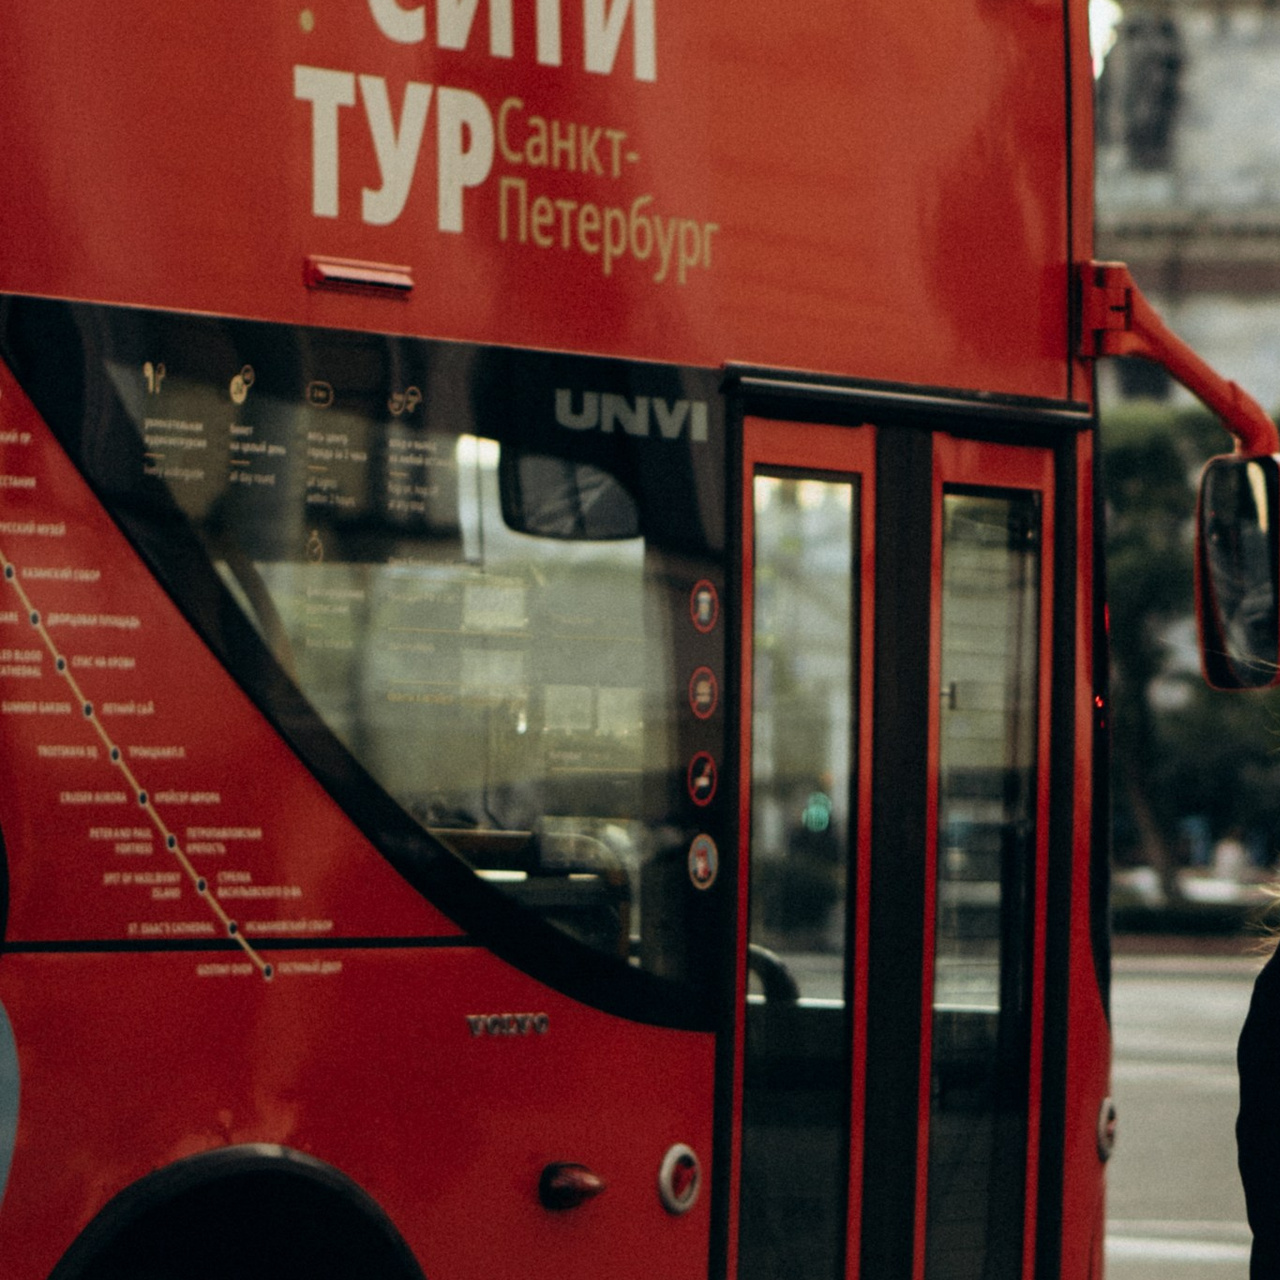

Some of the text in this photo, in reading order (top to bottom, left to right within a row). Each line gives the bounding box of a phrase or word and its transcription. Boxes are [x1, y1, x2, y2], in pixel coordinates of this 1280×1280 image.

[294, 64, 494, 233] ТУР
[498, 97, 640, 179] Санкт-
[499, 177, 720, 284] Петербург
[555, 388, 708, 442] UNVI
[466, 1012, 549, 1037] VOLVO
